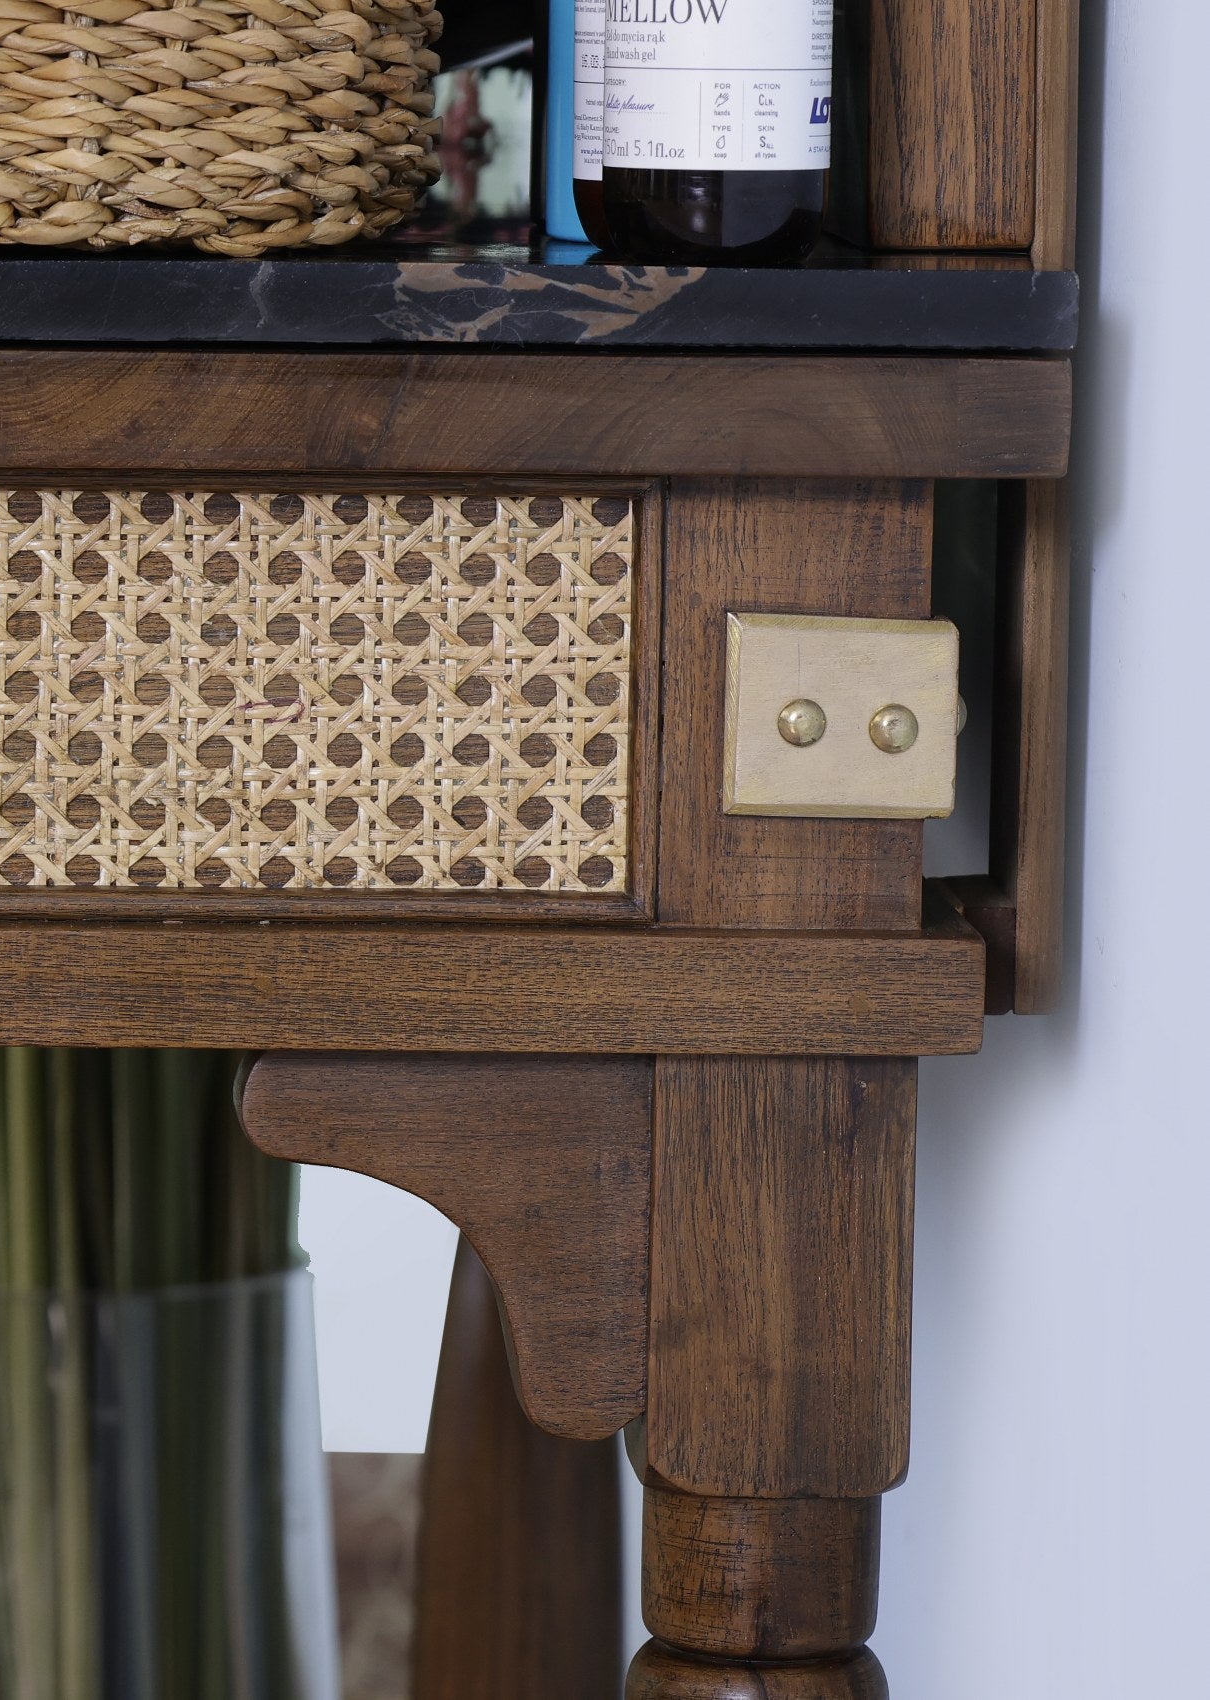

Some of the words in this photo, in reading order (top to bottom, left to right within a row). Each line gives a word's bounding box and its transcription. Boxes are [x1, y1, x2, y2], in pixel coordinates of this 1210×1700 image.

[606, 0, 728, 24] MELLOW
[621, 31, 645, 44] mycia
[647, 30, 665, 45] rąk
[619, 47, 640, 60] wash
[641, 48, 656, 62] gel
[714, 82, 731, 90] FOR
[617, 94, 655, 115] pleasure
[714, 152, 728, 160] soap
[762, 151, 776, 159] types
